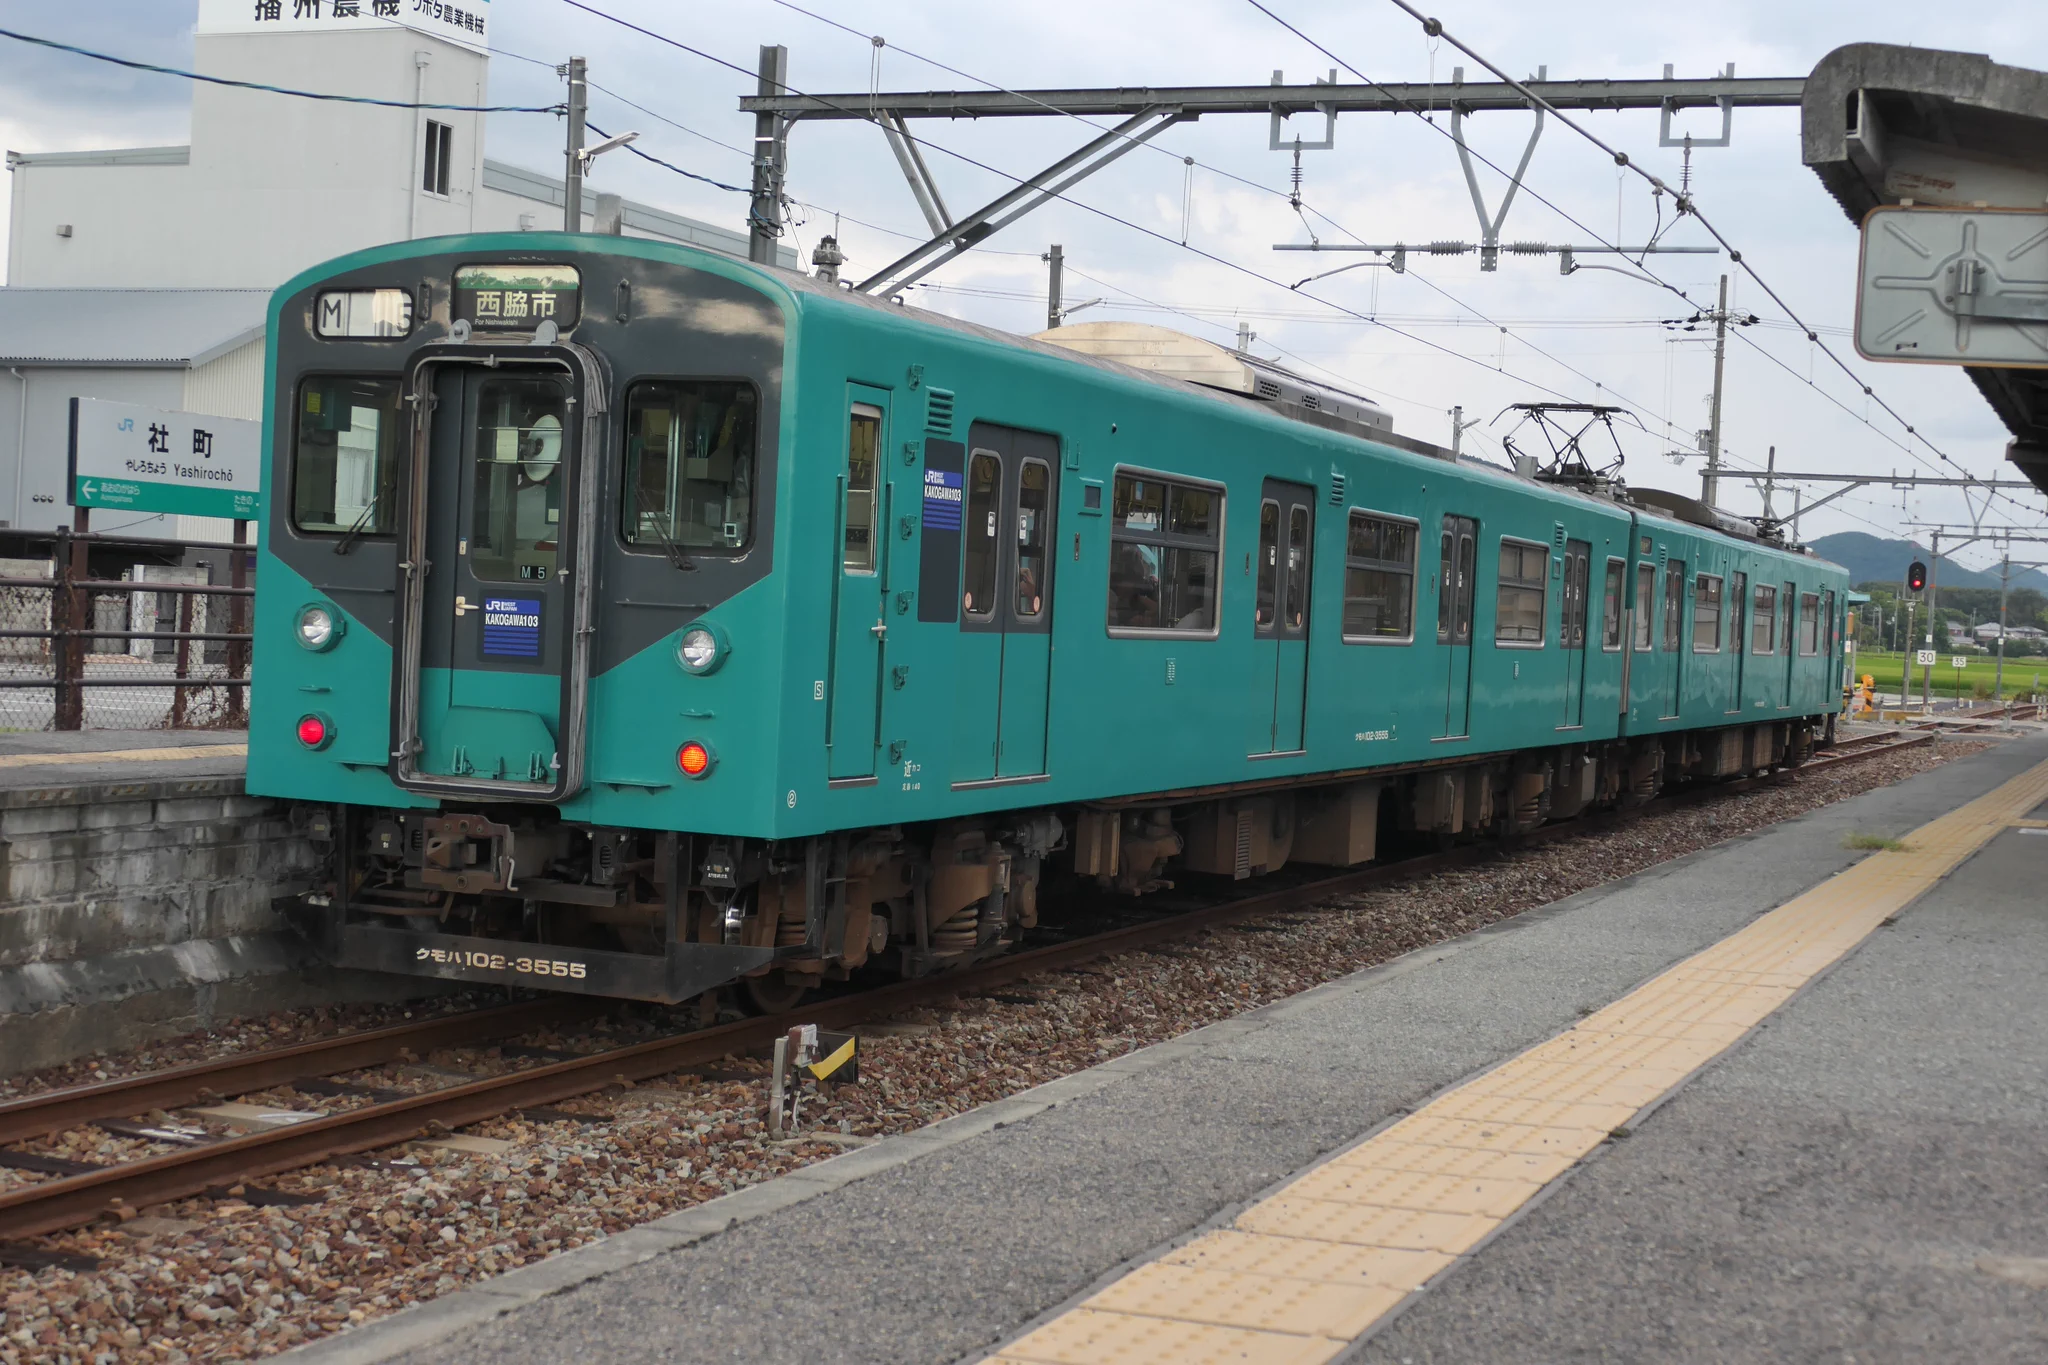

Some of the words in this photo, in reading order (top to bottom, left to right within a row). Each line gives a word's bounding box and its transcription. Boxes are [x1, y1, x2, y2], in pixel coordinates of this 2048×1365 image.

[476, 290, 557, 318] 西脇市
[322, 298, 342, 329] M
[118, 418, 134, 432] JR
[125, 459, 167, 475] やしろちょう
[925, 470, 934, 483] JR
[521, 566, 530, 578] M
[537, 567, 545, 578] 5
[486, 600, 501, 610] JR
[1920, 652, 1933, 662] 30
[1954, 657, 1964, 665] 35
[416, 948, 587, 979] クモハ102-3555
